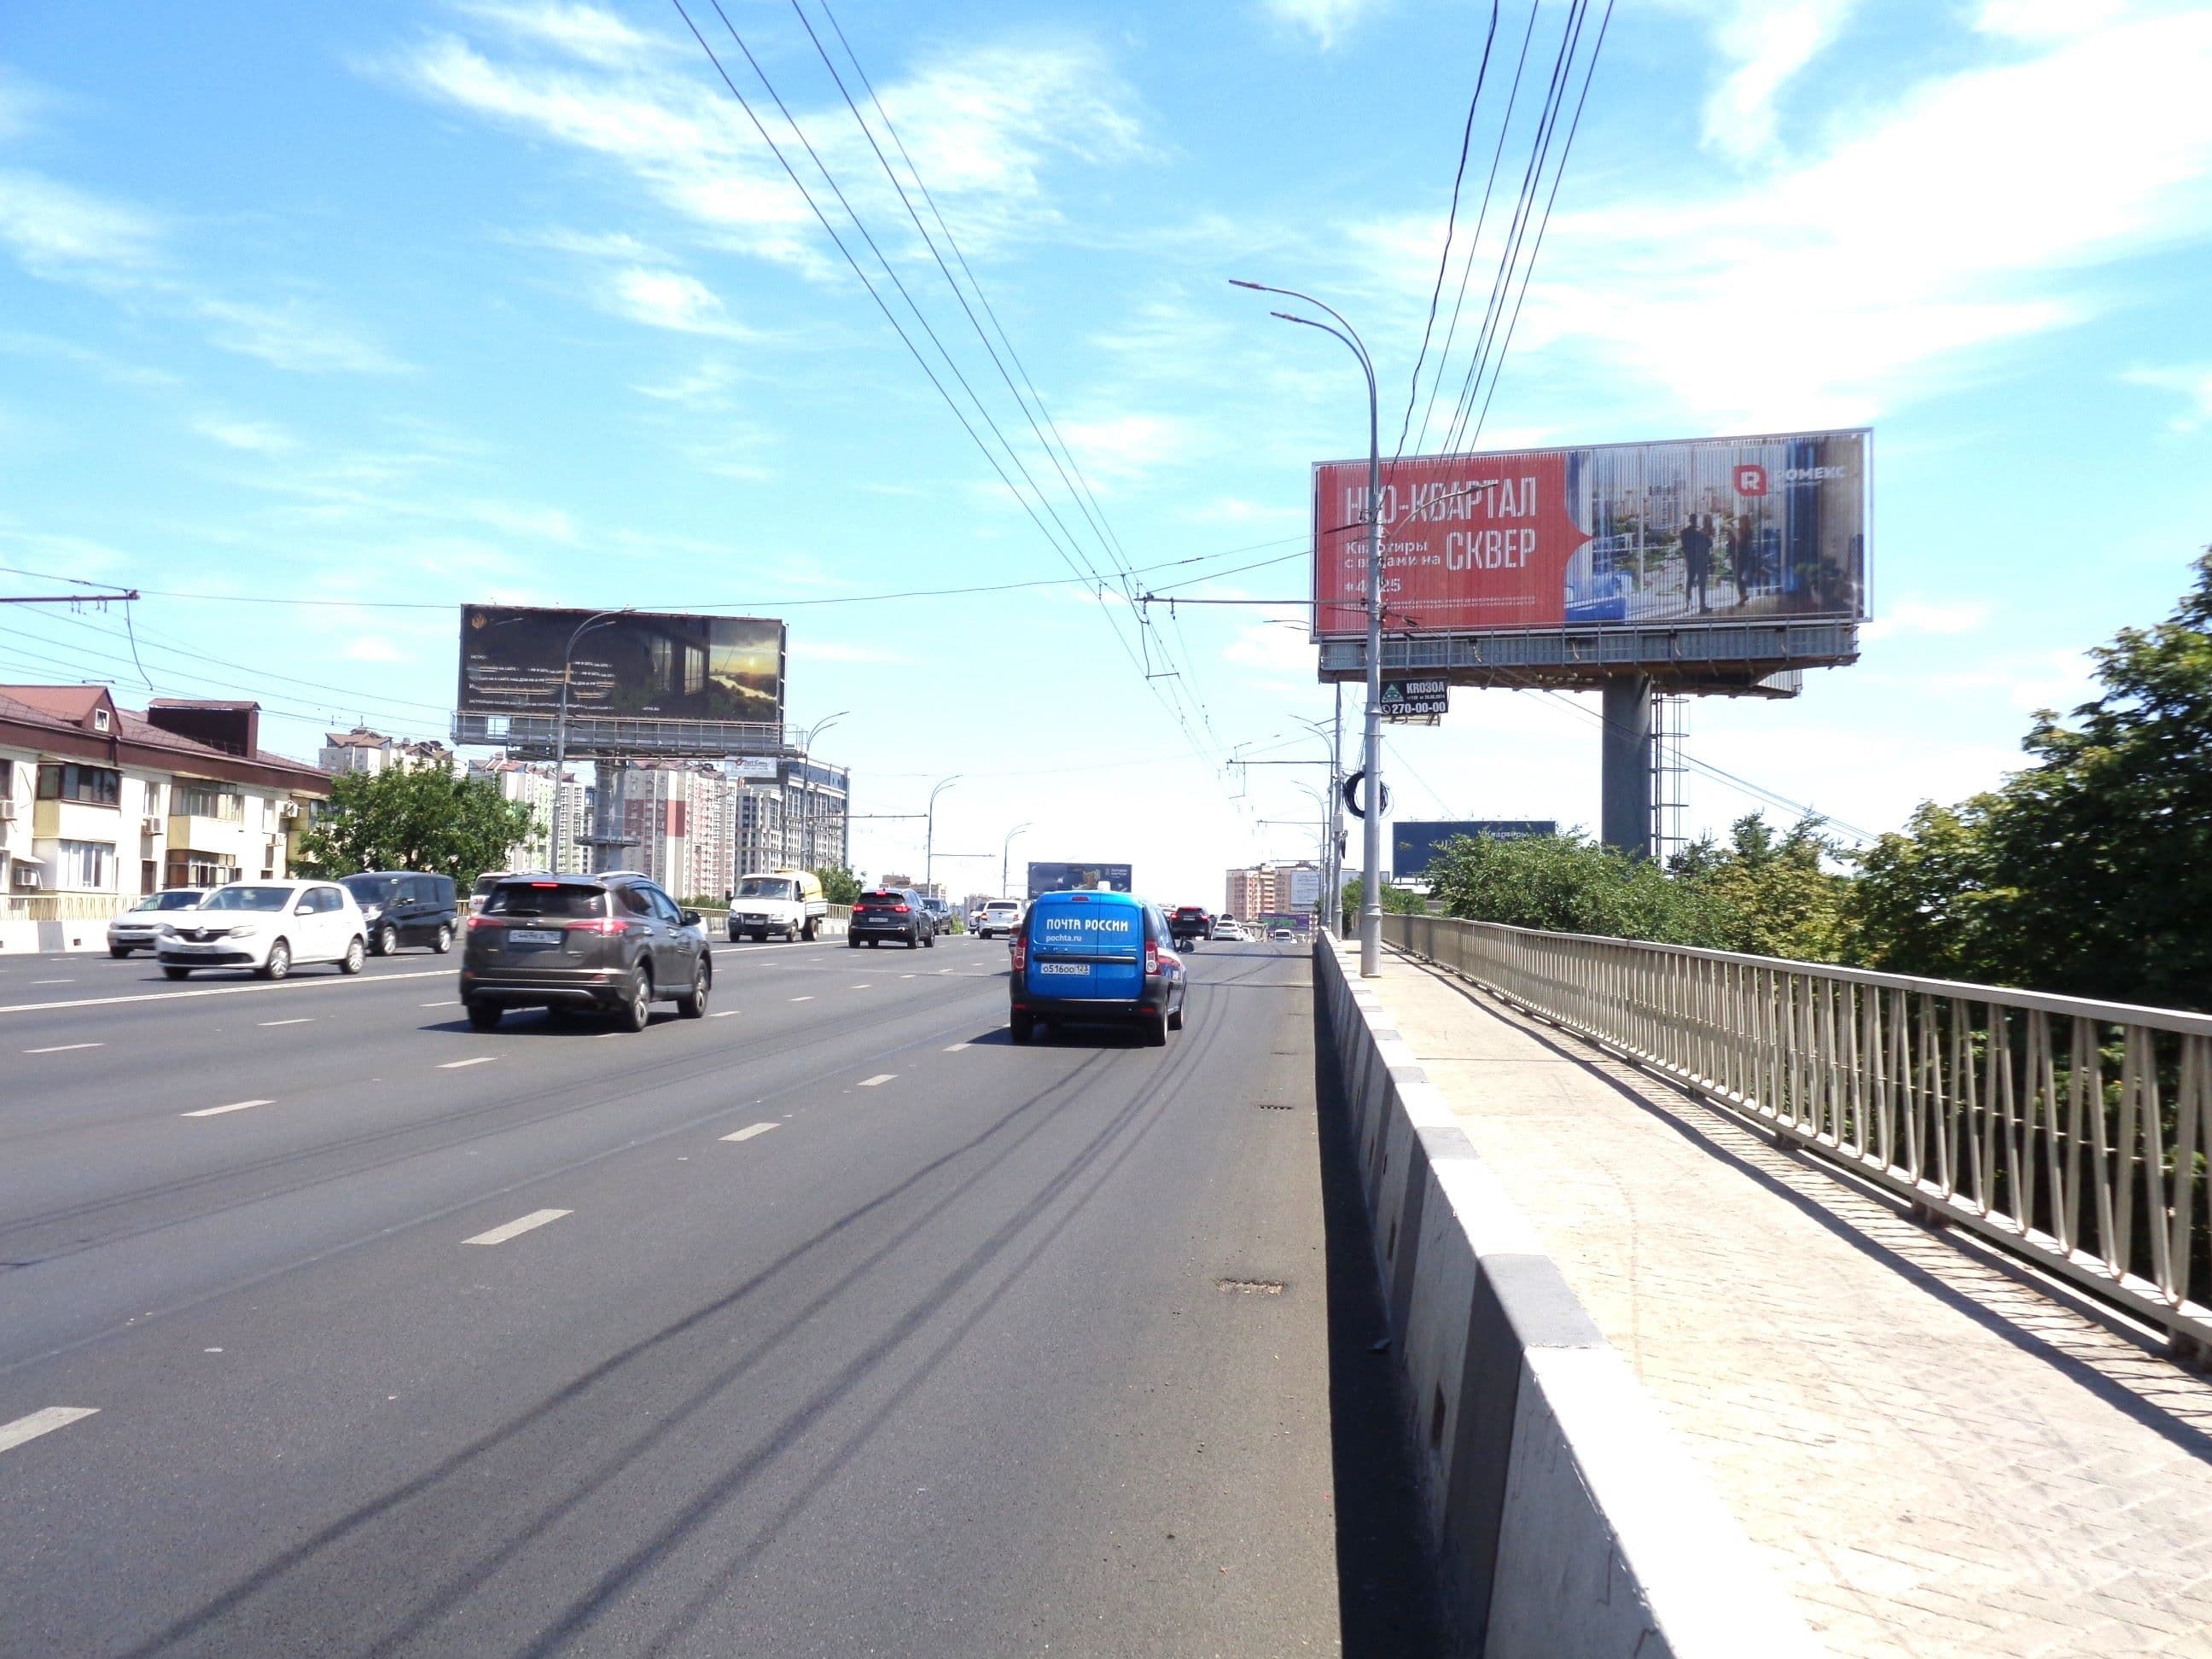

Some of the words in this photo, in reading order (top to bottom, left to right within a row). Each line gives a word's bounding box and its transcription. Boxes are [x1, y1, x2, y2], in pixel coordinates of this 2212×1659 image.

[1347, 476, 1536, 527] НО-КВАРТАЛ
[1347, 541, 1428, 556] Квртиры
[1447, 528, 1536, 571] СКВЕР
[1358, 556, 1417, 568] вдами
[1422, 554, 1441, 565] на
[1392, 701, 1446, 714] 270-00-00
[1046, 919, 1081, 930] ПОЧТА
[1085, 919, 1128, 931] РОССИИ
[1045, 934, 1082, 943] pochta.ru
